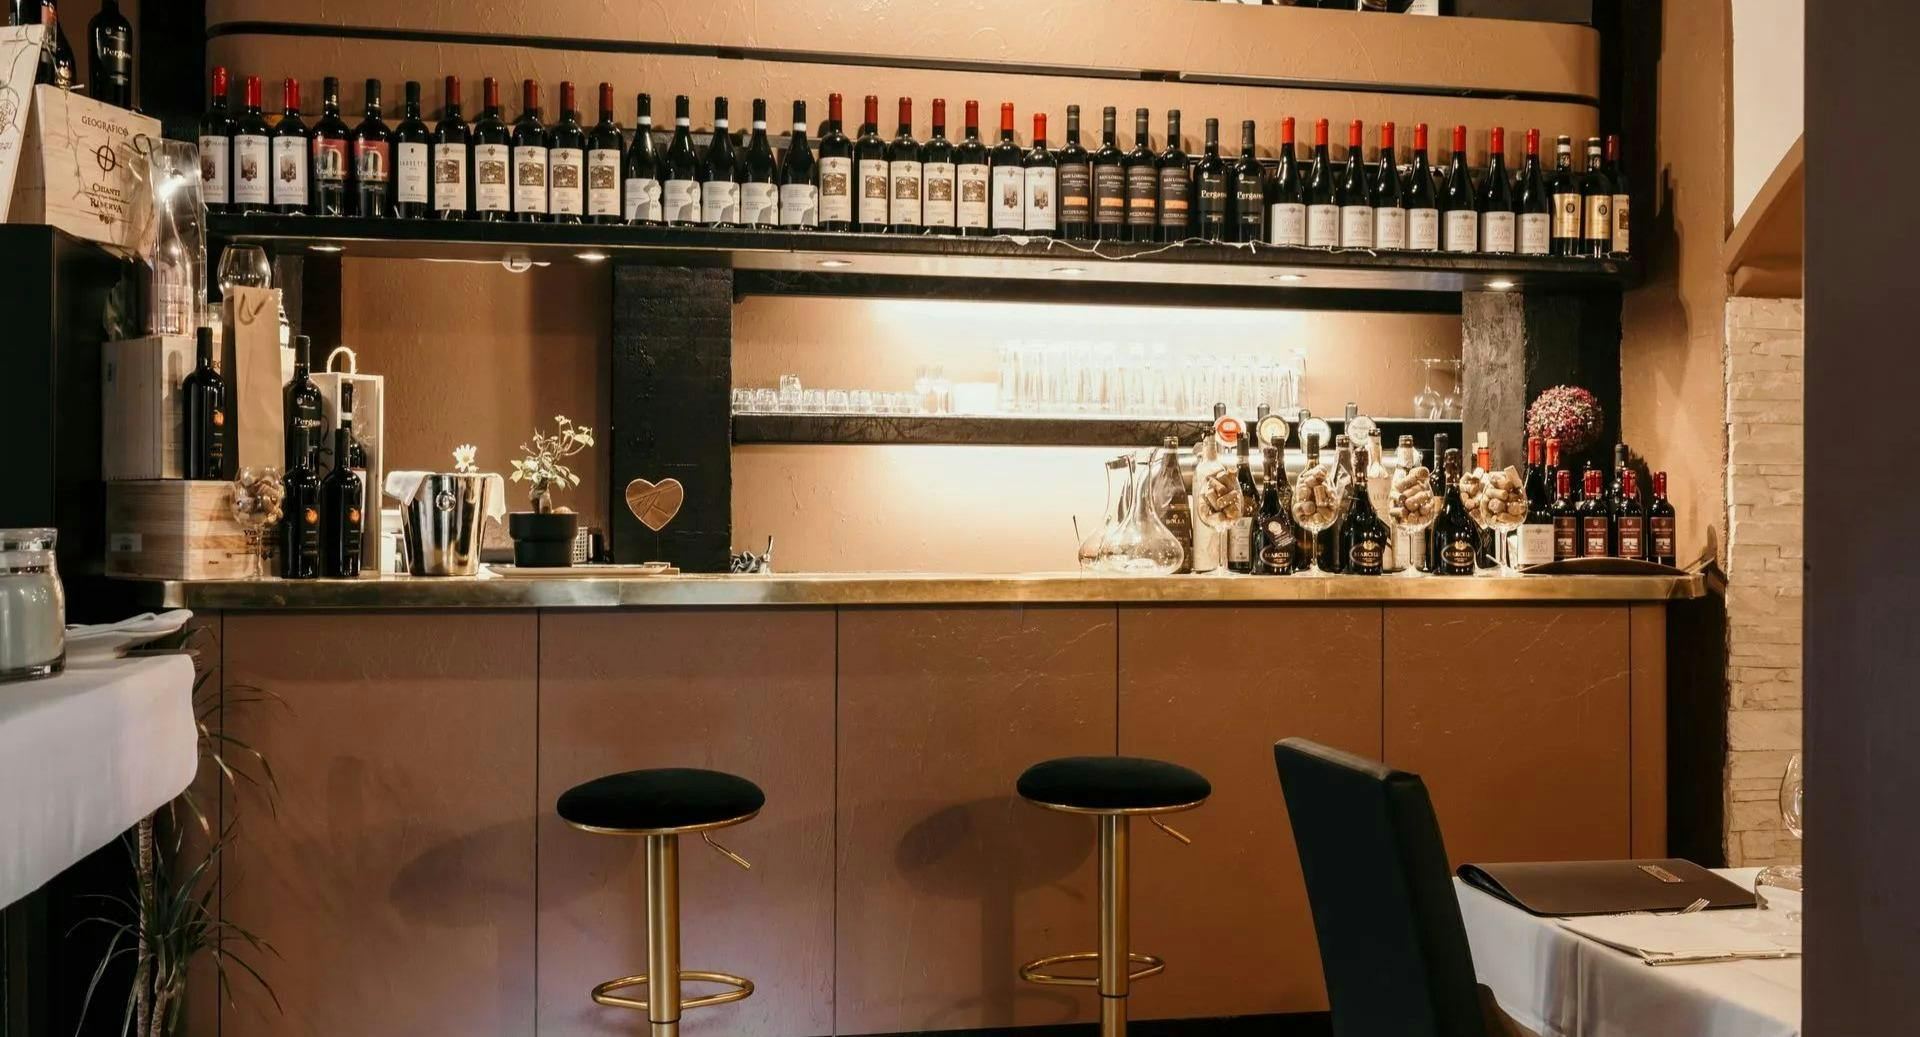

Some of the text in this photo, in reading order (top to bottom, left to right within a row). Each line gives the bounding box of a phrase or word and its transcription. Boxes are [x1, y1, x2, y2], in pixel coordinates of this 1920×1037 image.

[82, 115, 129, 137] GEOGRAFICO
[92, 182, 121, 196] CHIANTI
[89, 197, 123, 214] RISERVA
